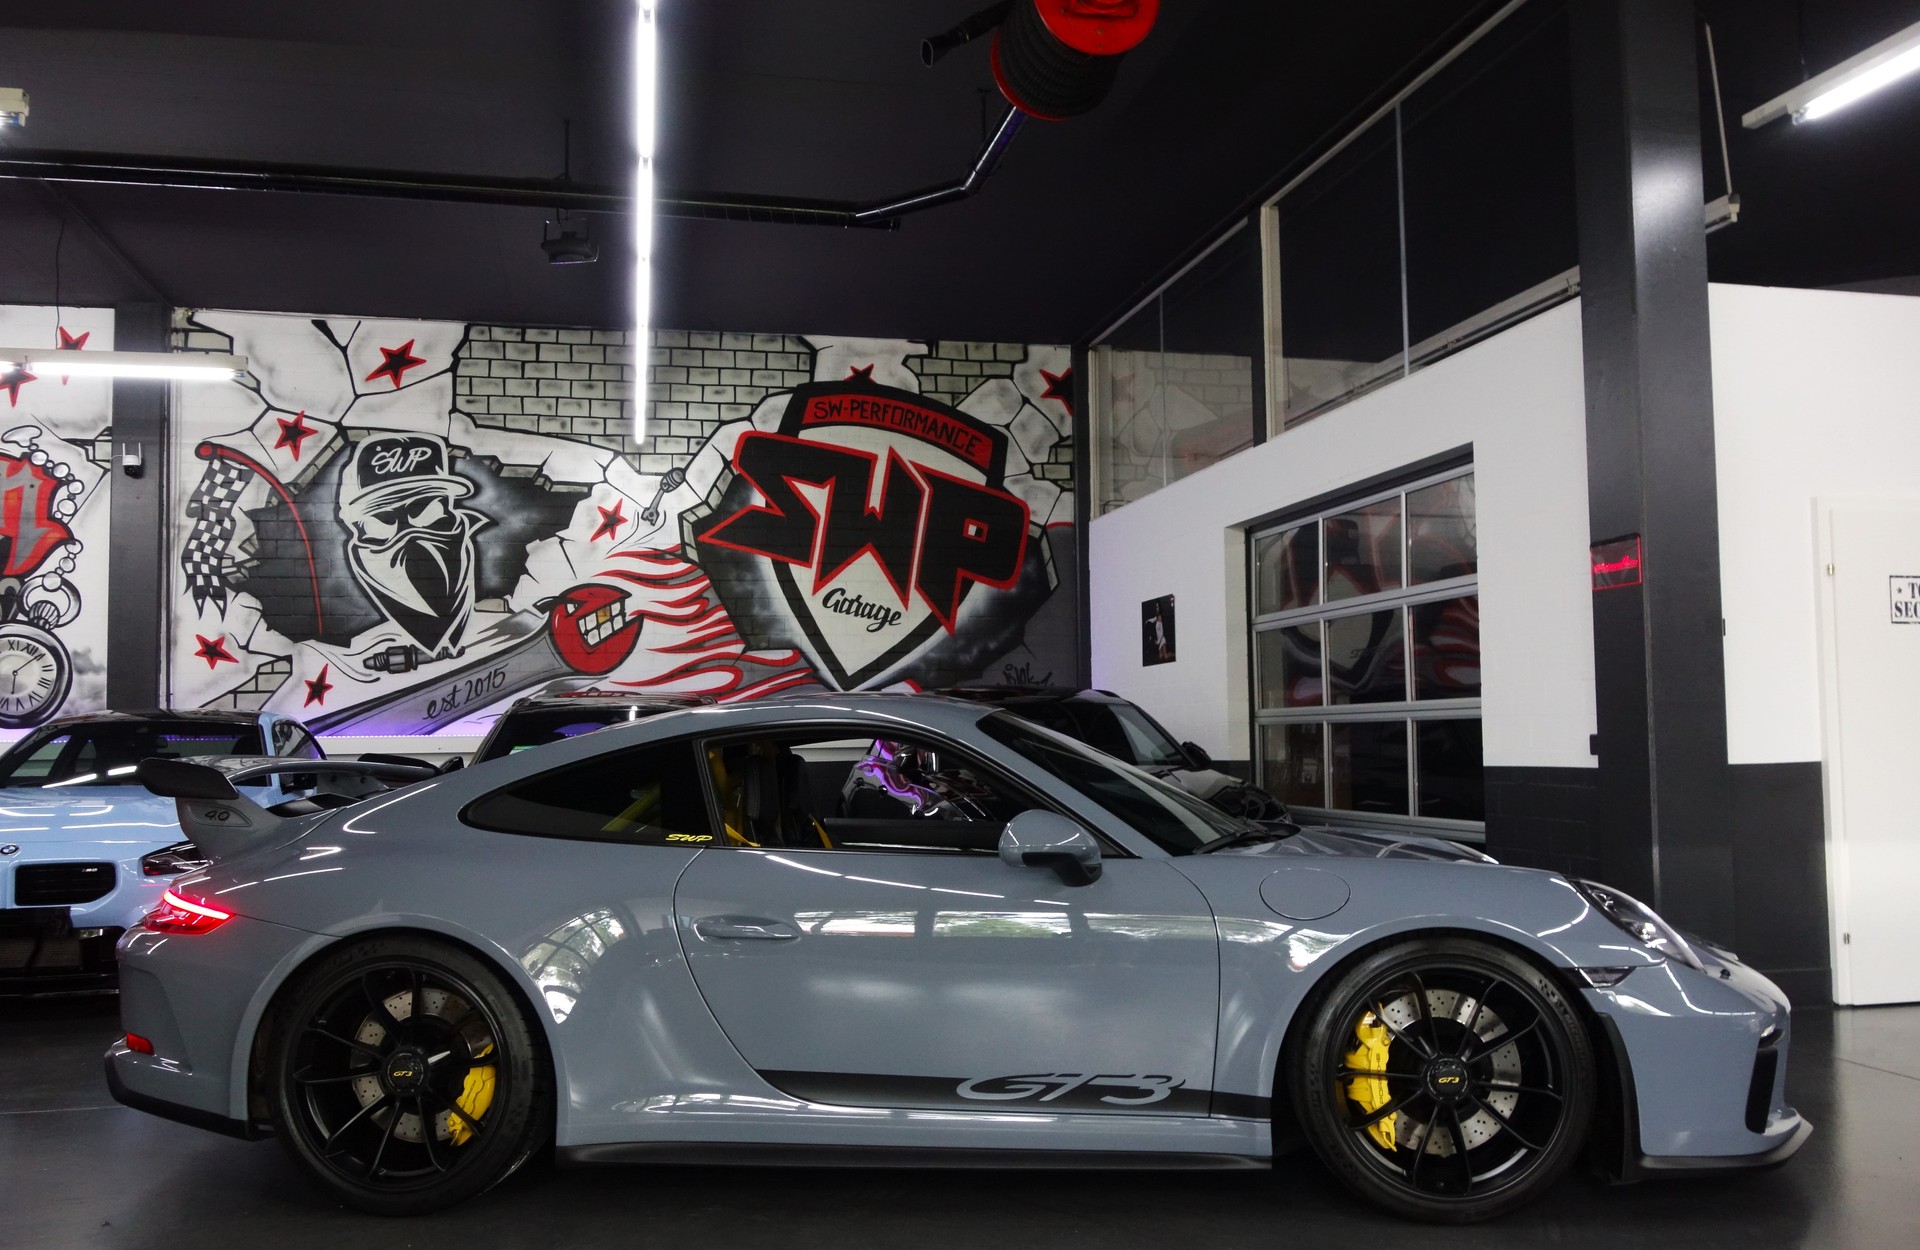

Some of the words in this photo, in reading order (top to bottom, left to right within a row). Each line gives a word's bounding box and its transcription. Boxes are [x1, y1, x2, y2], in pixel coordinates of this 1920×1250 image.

[813, 401, 983, 457] SW-PERFORMANCE
[370, 446, 432, 475] SWP
[697, 430, 1031, 637] SWP
[822, 587, 902, 633] Garage
[422, 685, 462, 720] est
[464, 663, 509, 705] 2015
[665, 833, 713, 842] SWP
[956, 1073, 1186, 1106] GT3
